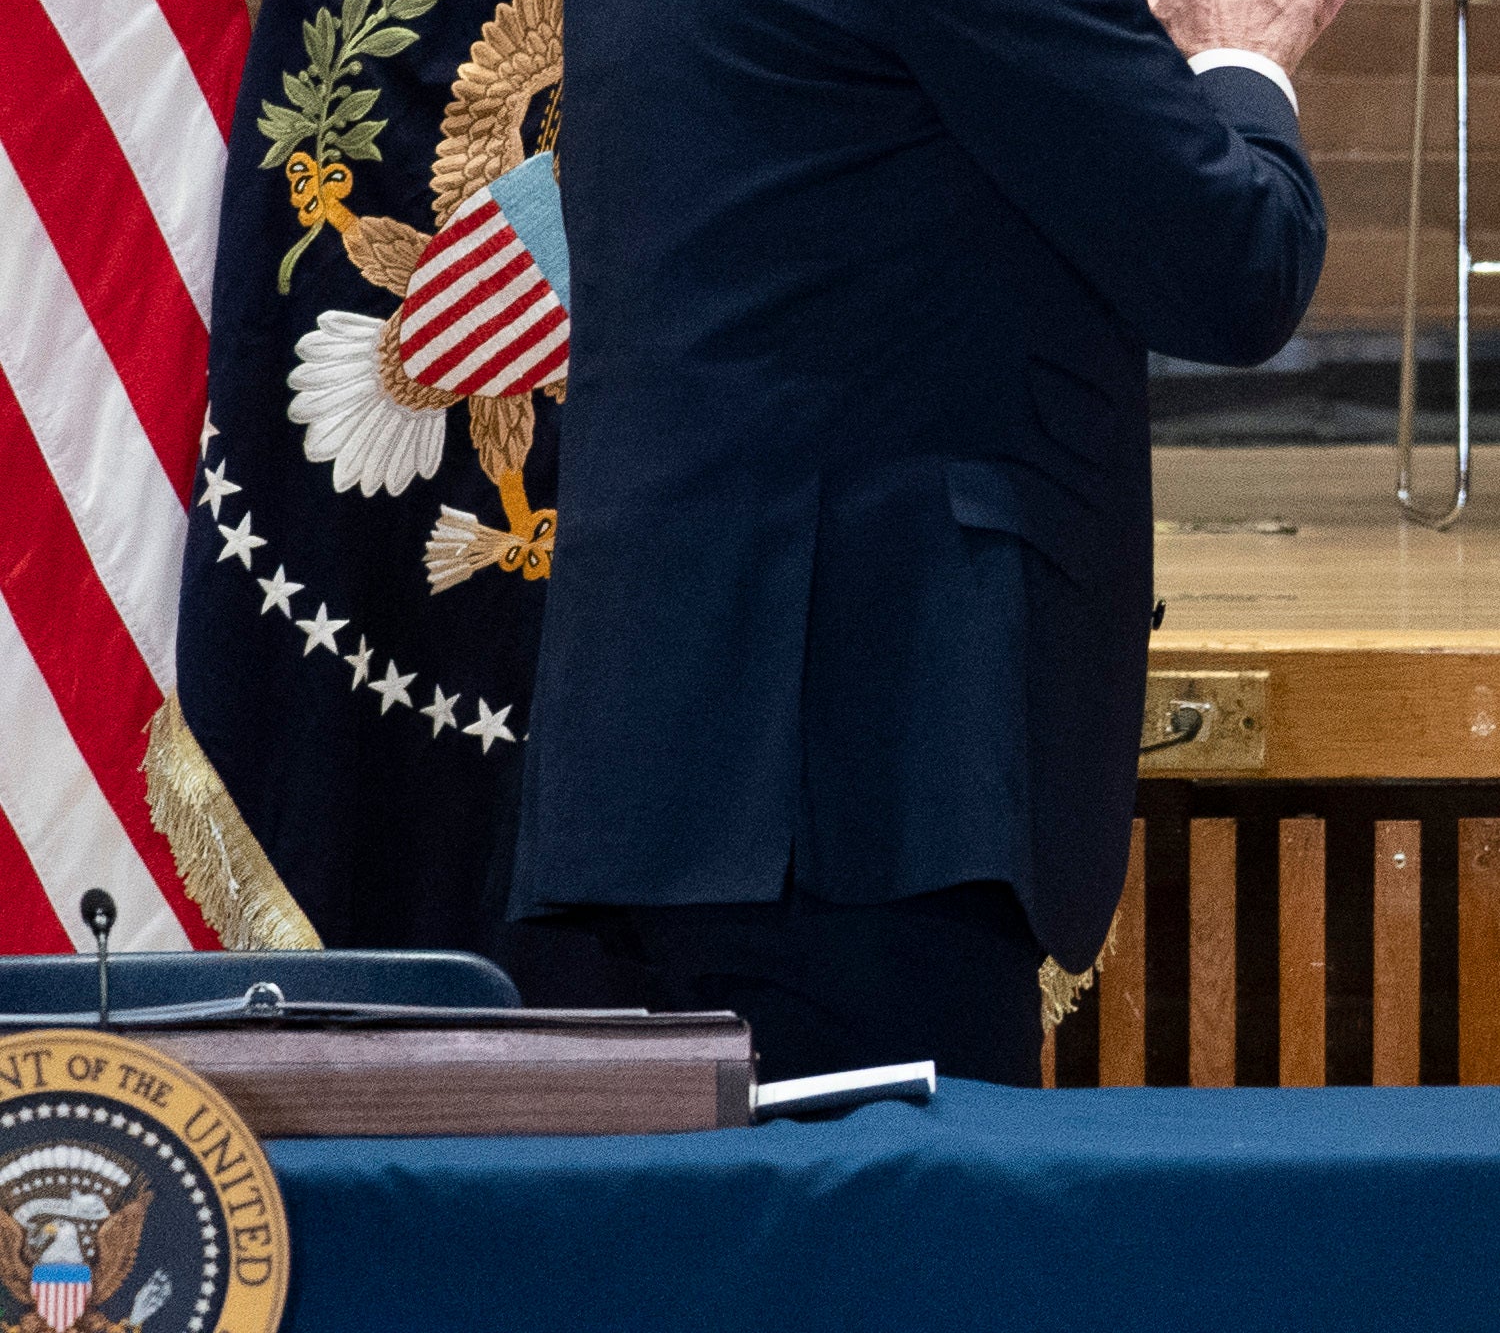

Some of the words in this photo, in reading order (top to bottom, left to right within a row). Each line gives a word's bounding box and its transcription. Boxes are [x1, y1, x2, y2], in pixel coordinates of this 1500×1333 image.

[66, 1054, 108, 1082] OF
[118, 1063, 174, 1109] THE
[182, 1107, 274, 1287] UNITED
